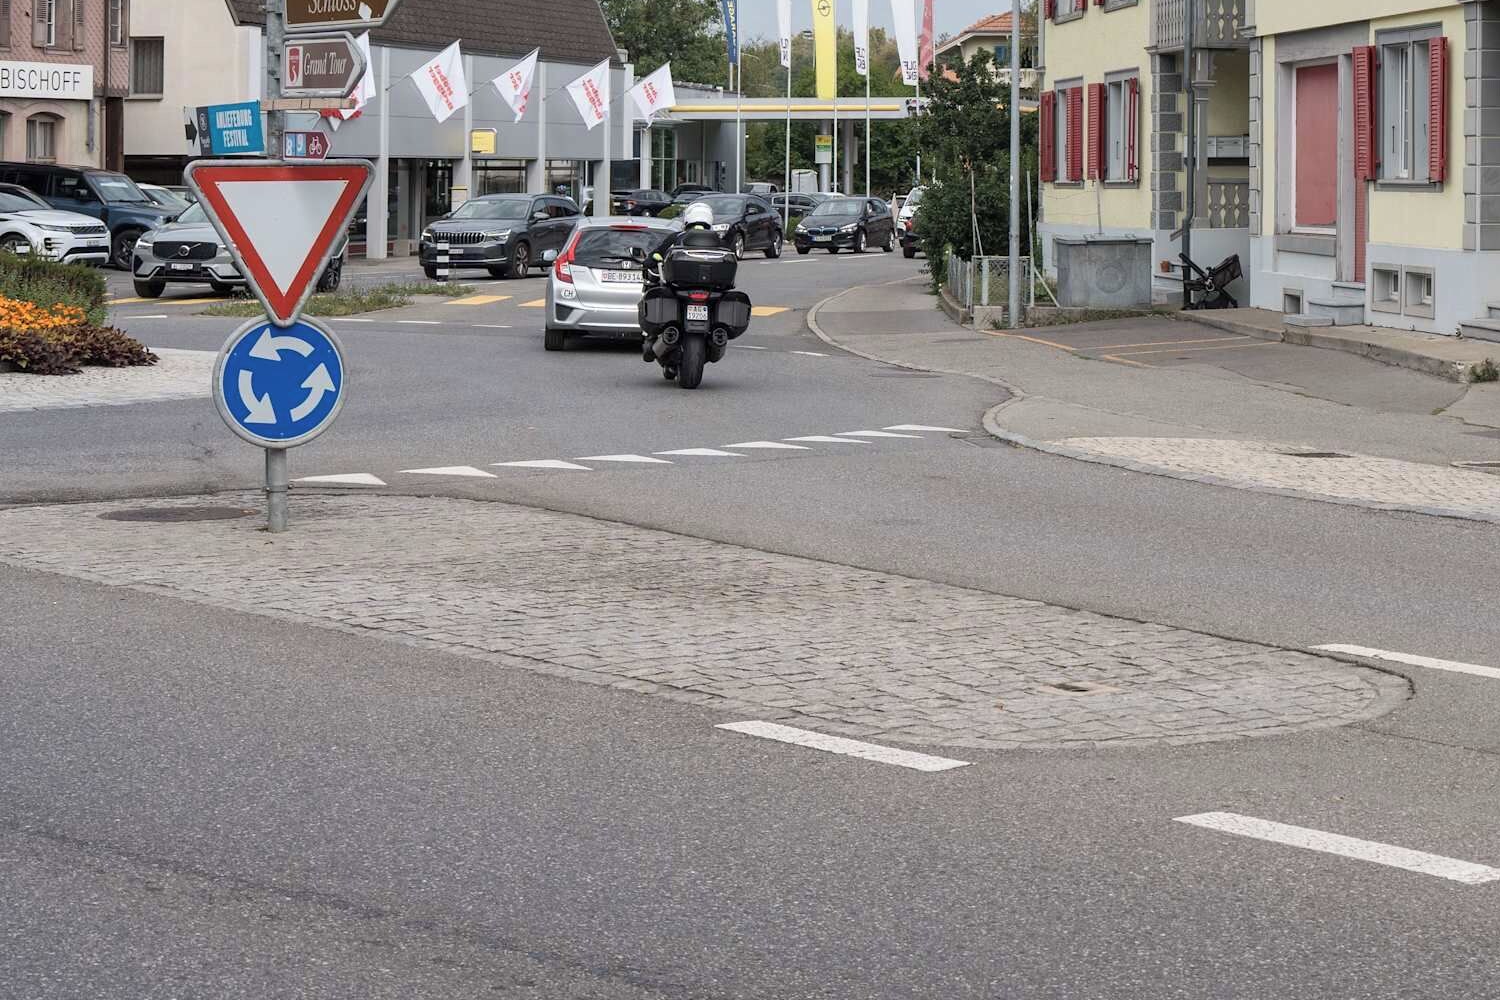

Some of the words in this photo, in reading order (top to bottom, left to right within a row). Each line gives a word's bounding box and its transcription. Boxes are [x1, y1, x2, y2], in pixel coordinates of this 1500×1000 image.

[304, 52, 328, 76] Grand
[329, 52, 347, 75] Tour
[1, 68, 81, 91] BISCHOFF
[223, 129, 249, 148] FESTIVAL
[563, 289, 575, 297] CH
